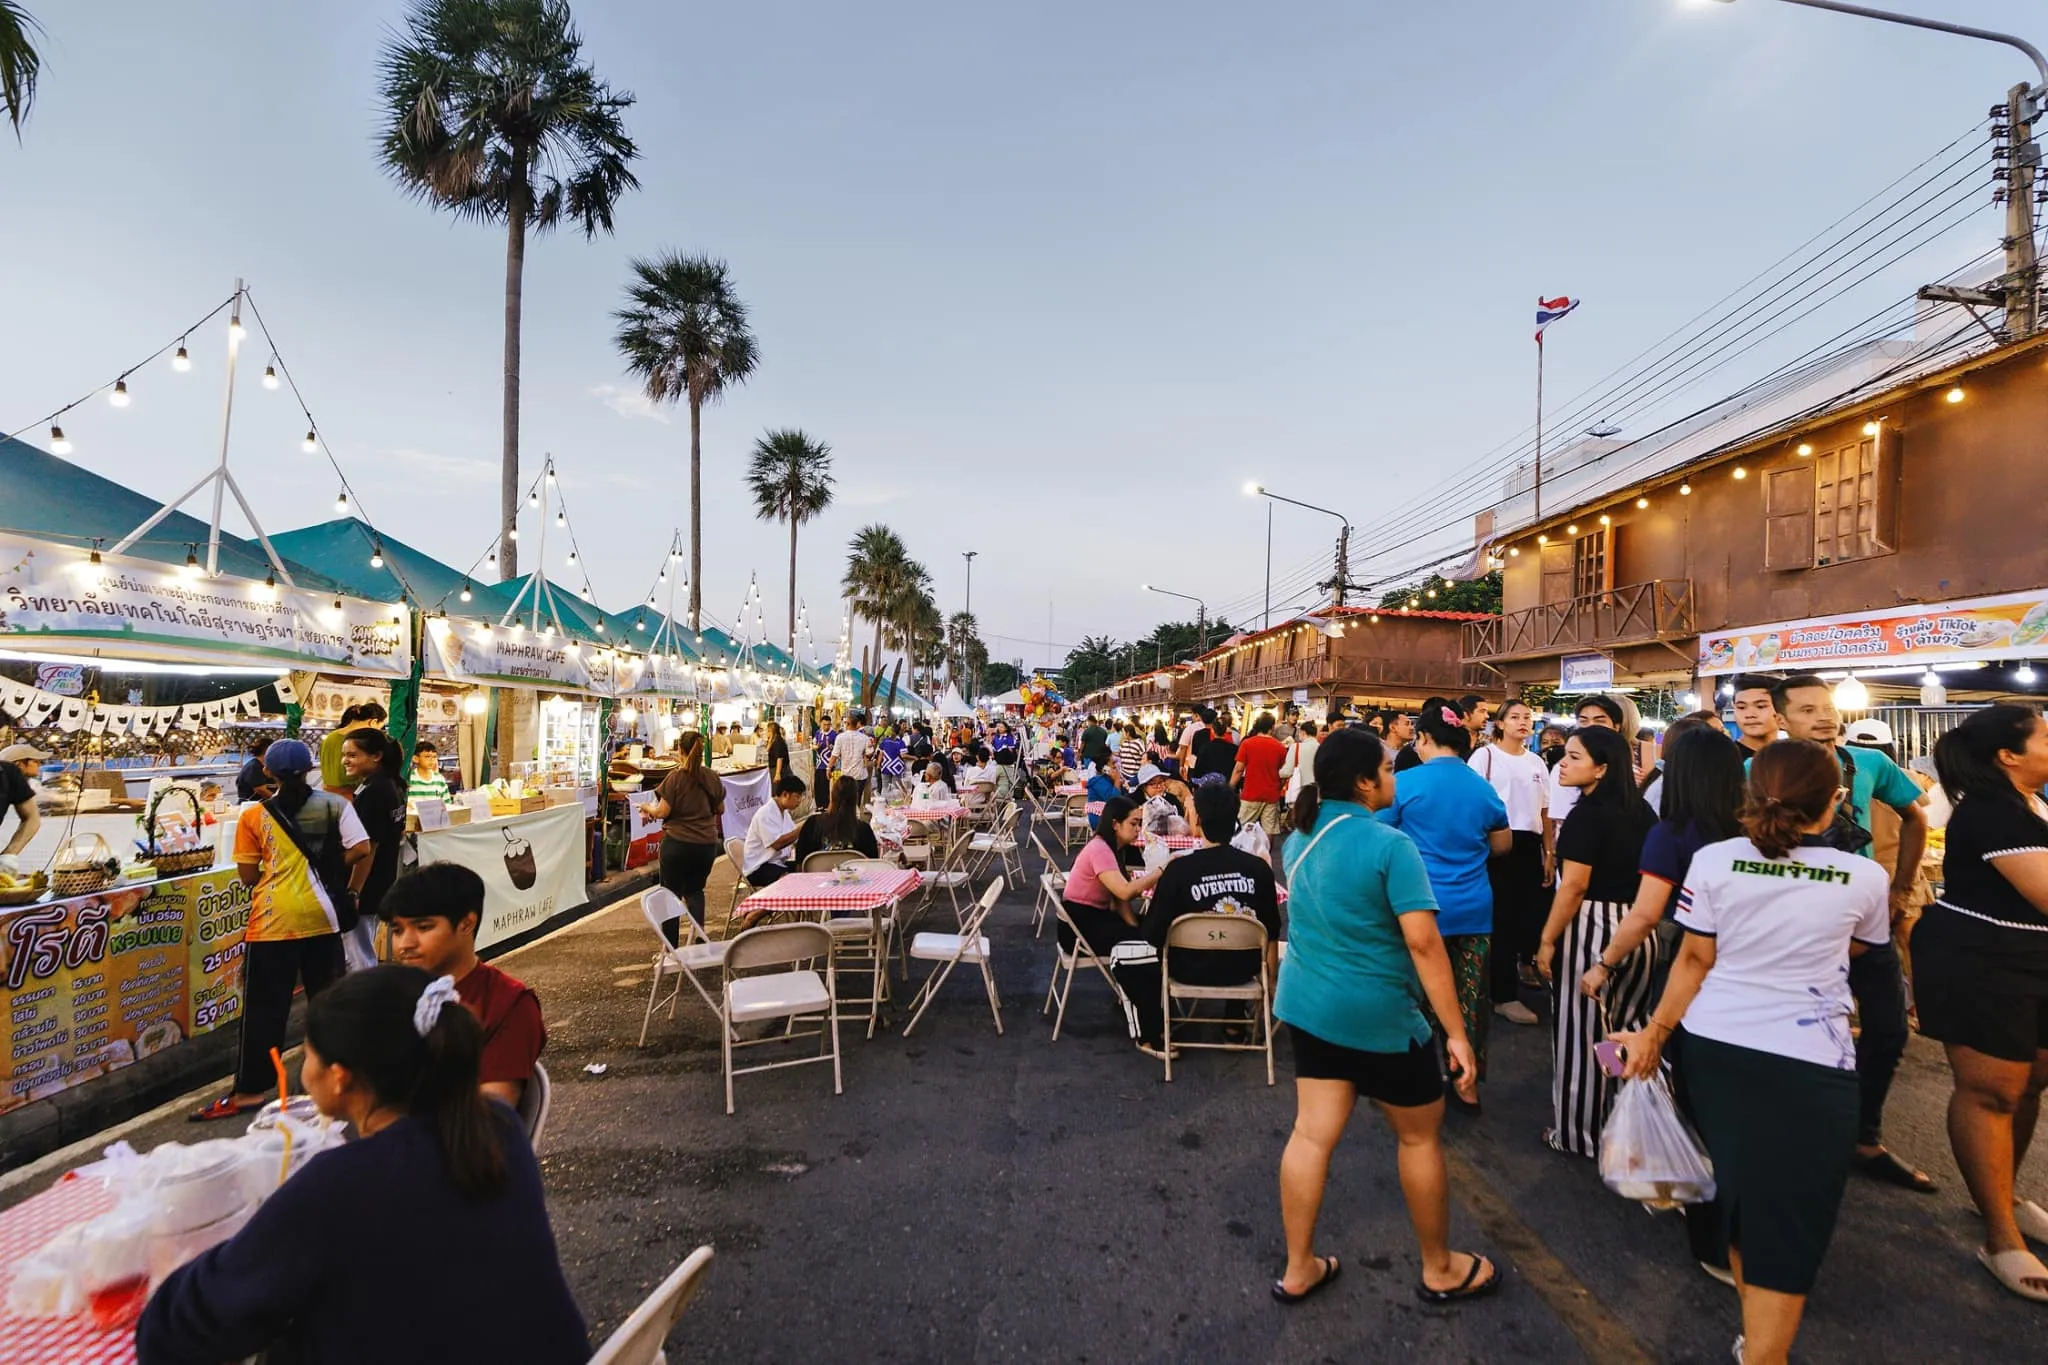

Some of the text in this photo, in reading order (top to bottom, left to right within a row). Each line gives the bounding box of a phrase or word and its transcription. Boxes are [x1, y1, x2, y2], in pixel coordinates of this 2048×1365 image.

[1940, 619, 1977, 632] TikTok
[496, 641, 566, 664] MAPHRAW CAFE
[1904, 639, 1911, 648] 1
[41, 665, 82, 687] Food
[1731, 860, 1851, 885] กรมเจ้าท่า
[198, 881, 252, 917] ข้าวโพ
[156, 905, 184, 921] อร่อย
[493, 895, 553, 933] MAPHRAW CAFE
[8, 905, 111, 988] โรตี
[111, 925, 183, 954] หอมเนย
[203, 954, 222, 973] 25
[223, 942, 246, 962] บาท
[84, 974, 104, 985] บาท
[87, 989, 107, 1001] บาท
[74, 1010, 87, 1023] 30
[89, 1004, 108, 1017] บาท
[197, 1005, 218, 1026] 59
[218, 996, 238, 1017] บาท
[75, 1027, 88, 1040] 30
[89, 1020, 109, 1033] บาท
[75, 1044, 88, 1056] 25
[90, 1036, 109, 1049] บาท
[75, 1060, 89, 1073] 30
